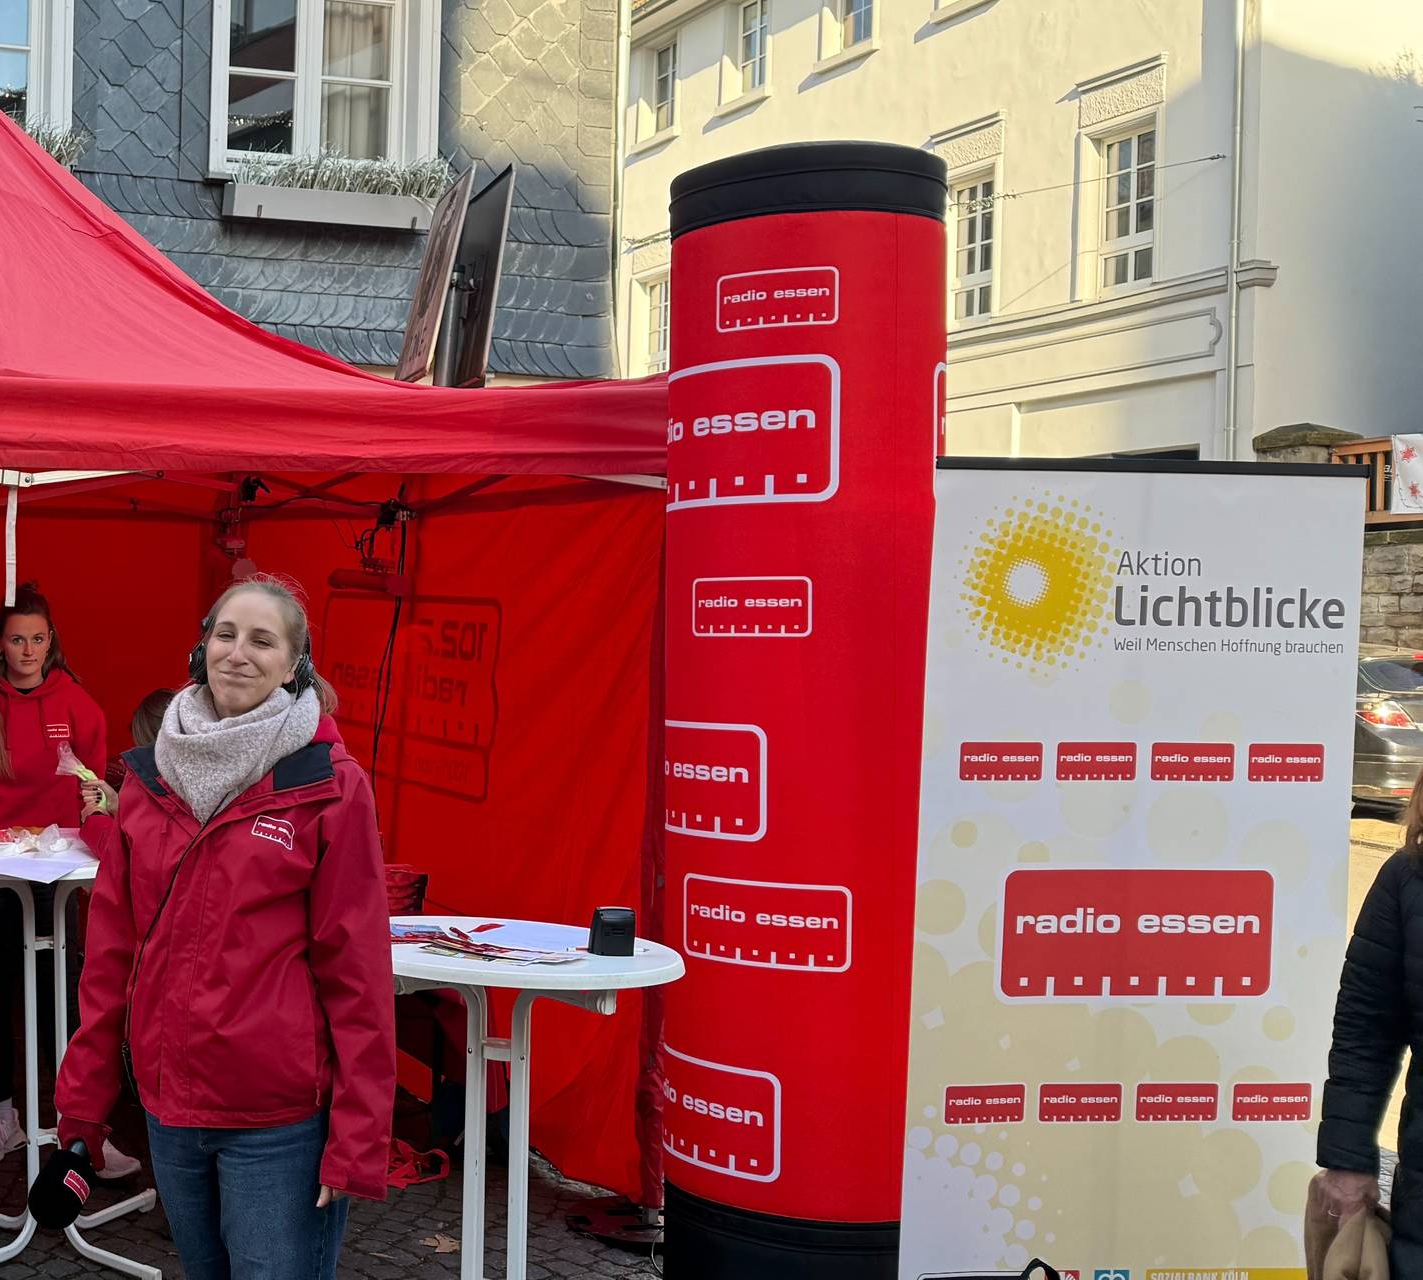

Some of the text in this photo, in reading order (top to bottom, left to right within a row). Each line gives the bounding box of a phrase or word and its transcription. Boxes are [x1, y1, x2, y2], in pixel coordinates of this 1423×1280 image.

[723, 287, 830, 305] radio essen
[692, 409, 816, 437] essen
[1116, 550, 1202, 577] Aktion
[698, 595, 803, 608] radio essen
[1114, 584, 1346, 630] Lichtblicke
[1113, 637, 1344, 656] Weil Menschen Hoffnung brauchen
[963, 753, 1040, 763] radio essen
[1059, 753, 1133, 763] radio essen
[1154, 753, 1232, 763] radio essen
[1251, 754, 1321, 764] radio essen
[673, 762, 749, 784] essen
[690, 903, 839, 930] radio essen
[1016, 907, 1260, 935] radio essen
[949, 1096, 1021, 1106] radio essen
[1043, 1095, 1118, 1104] radio essen
[1139, 1094, 1173, 1103] radio
[1236, 1094, 1309, 1104] radio essen
[682, 1094, 764, 1127] essen
